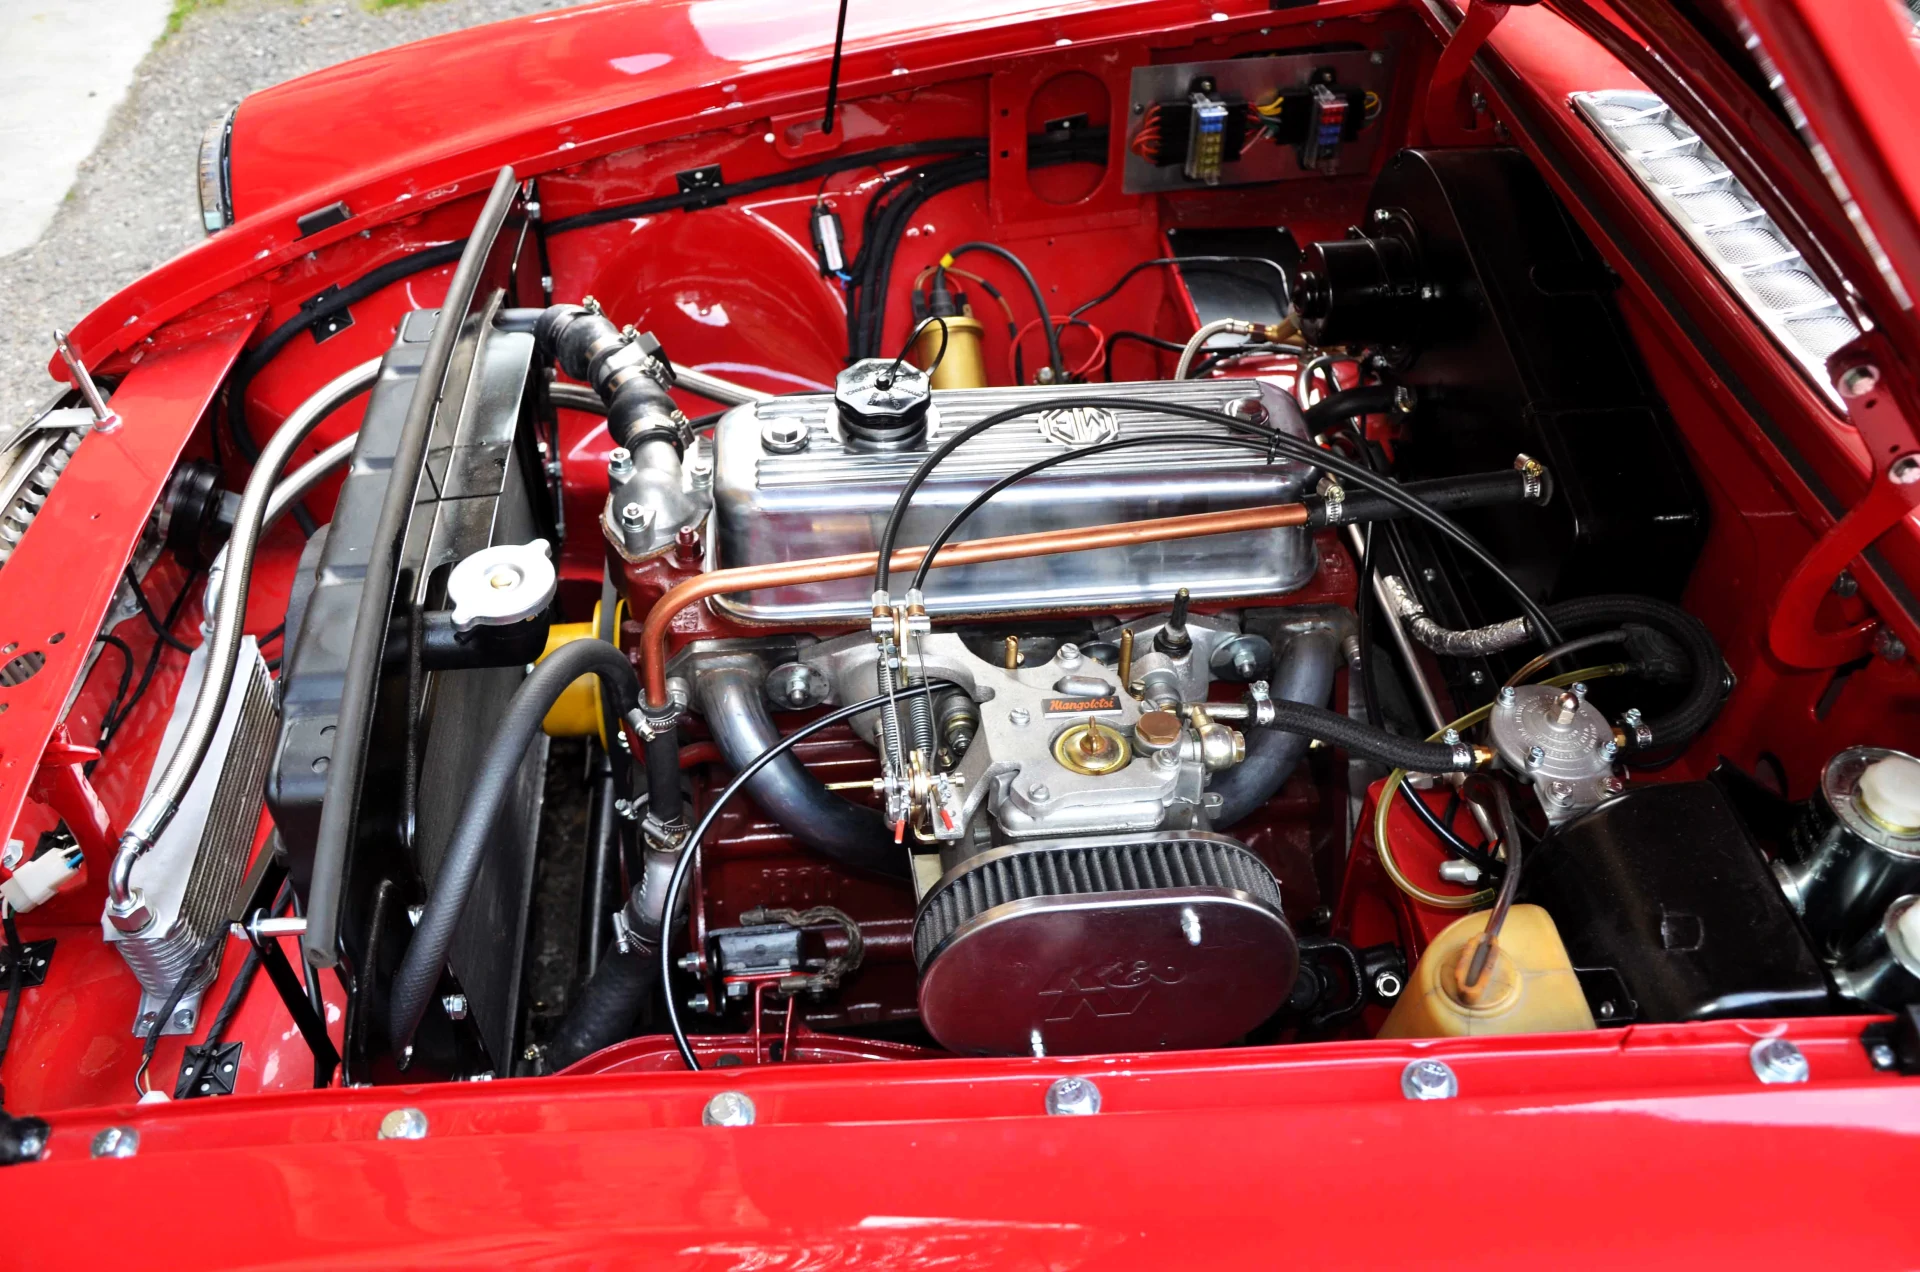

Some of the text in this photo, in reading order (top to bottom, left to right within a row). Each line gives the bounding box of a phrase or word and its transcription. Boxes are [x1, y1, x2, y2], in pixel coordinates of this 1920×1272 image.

[1045, 406, 1111, 443] MG
[1049, 697, 1115, 712] Mangoletsi
[1037, 959, 1187, 1022] K&N
